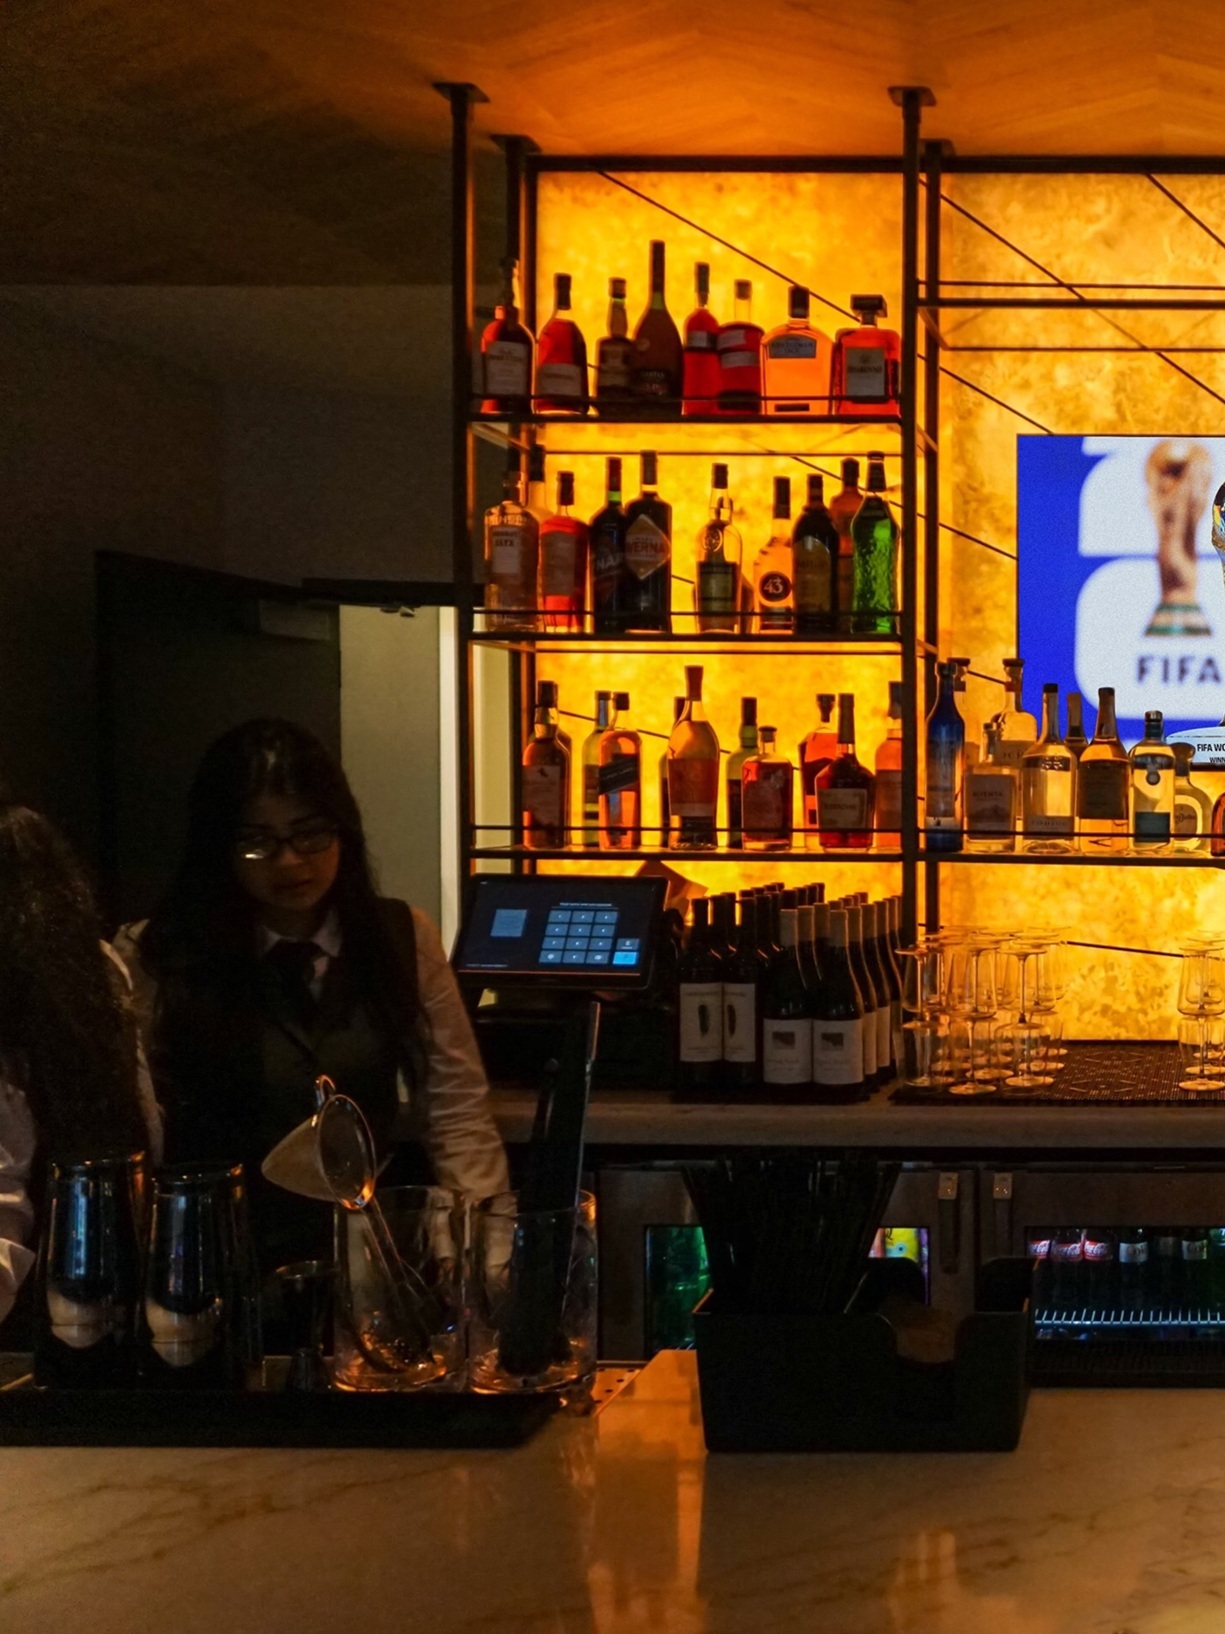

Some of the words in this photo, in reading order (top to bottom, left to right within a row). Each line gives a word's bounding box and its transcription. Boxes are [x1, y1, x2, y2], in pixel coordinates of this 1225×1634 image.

[763, 576, 783, 594] 43
[1137, 655, 1221, 683] FIFA
[1197, 743, 1213, 752] FIFA
